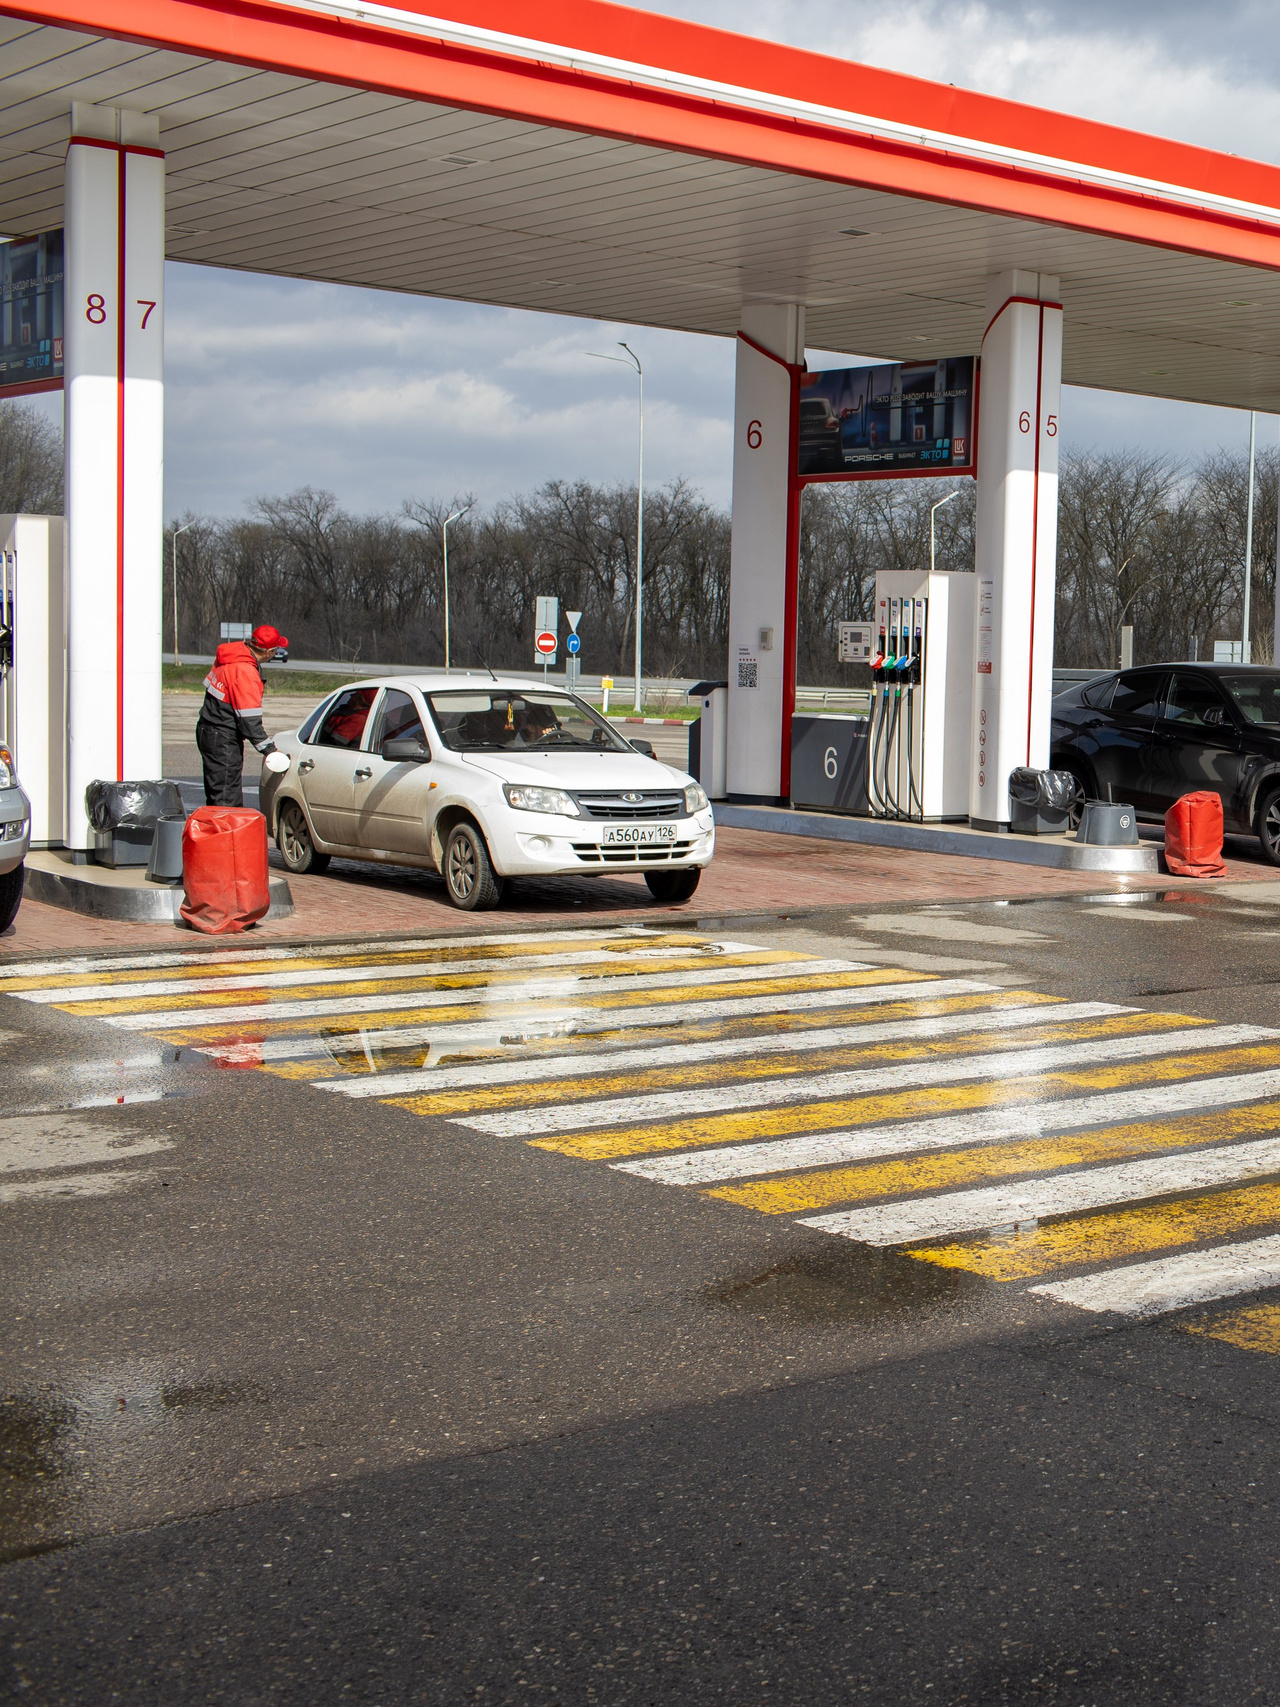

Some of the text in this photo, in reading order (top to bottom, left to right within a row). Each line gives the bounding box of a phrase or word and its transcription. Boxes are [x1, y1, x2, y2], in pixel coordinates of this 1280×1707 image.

[86, 293, 106, 324] 8
[137, 299, 156, 330] 7
[875, 395, 889, 403] ЭКТО
[902, 391, 925, 401] ЗАВОДИТ
[926, 390, 941, 400] ВАШУ
[942, 388, 968, 398] МАШИНУ
[1019, 411, 1030, 433] 6
[1047, 415, 1057, 437] 5
[747, 419, 762, 449] 6
[844, 453, 894, 462] PORSCHE
[920, 450, 942, 460] ЭКТО
[824, 746, 838, 779] 6
[607, 826, 674, 843] А560АУ 126
